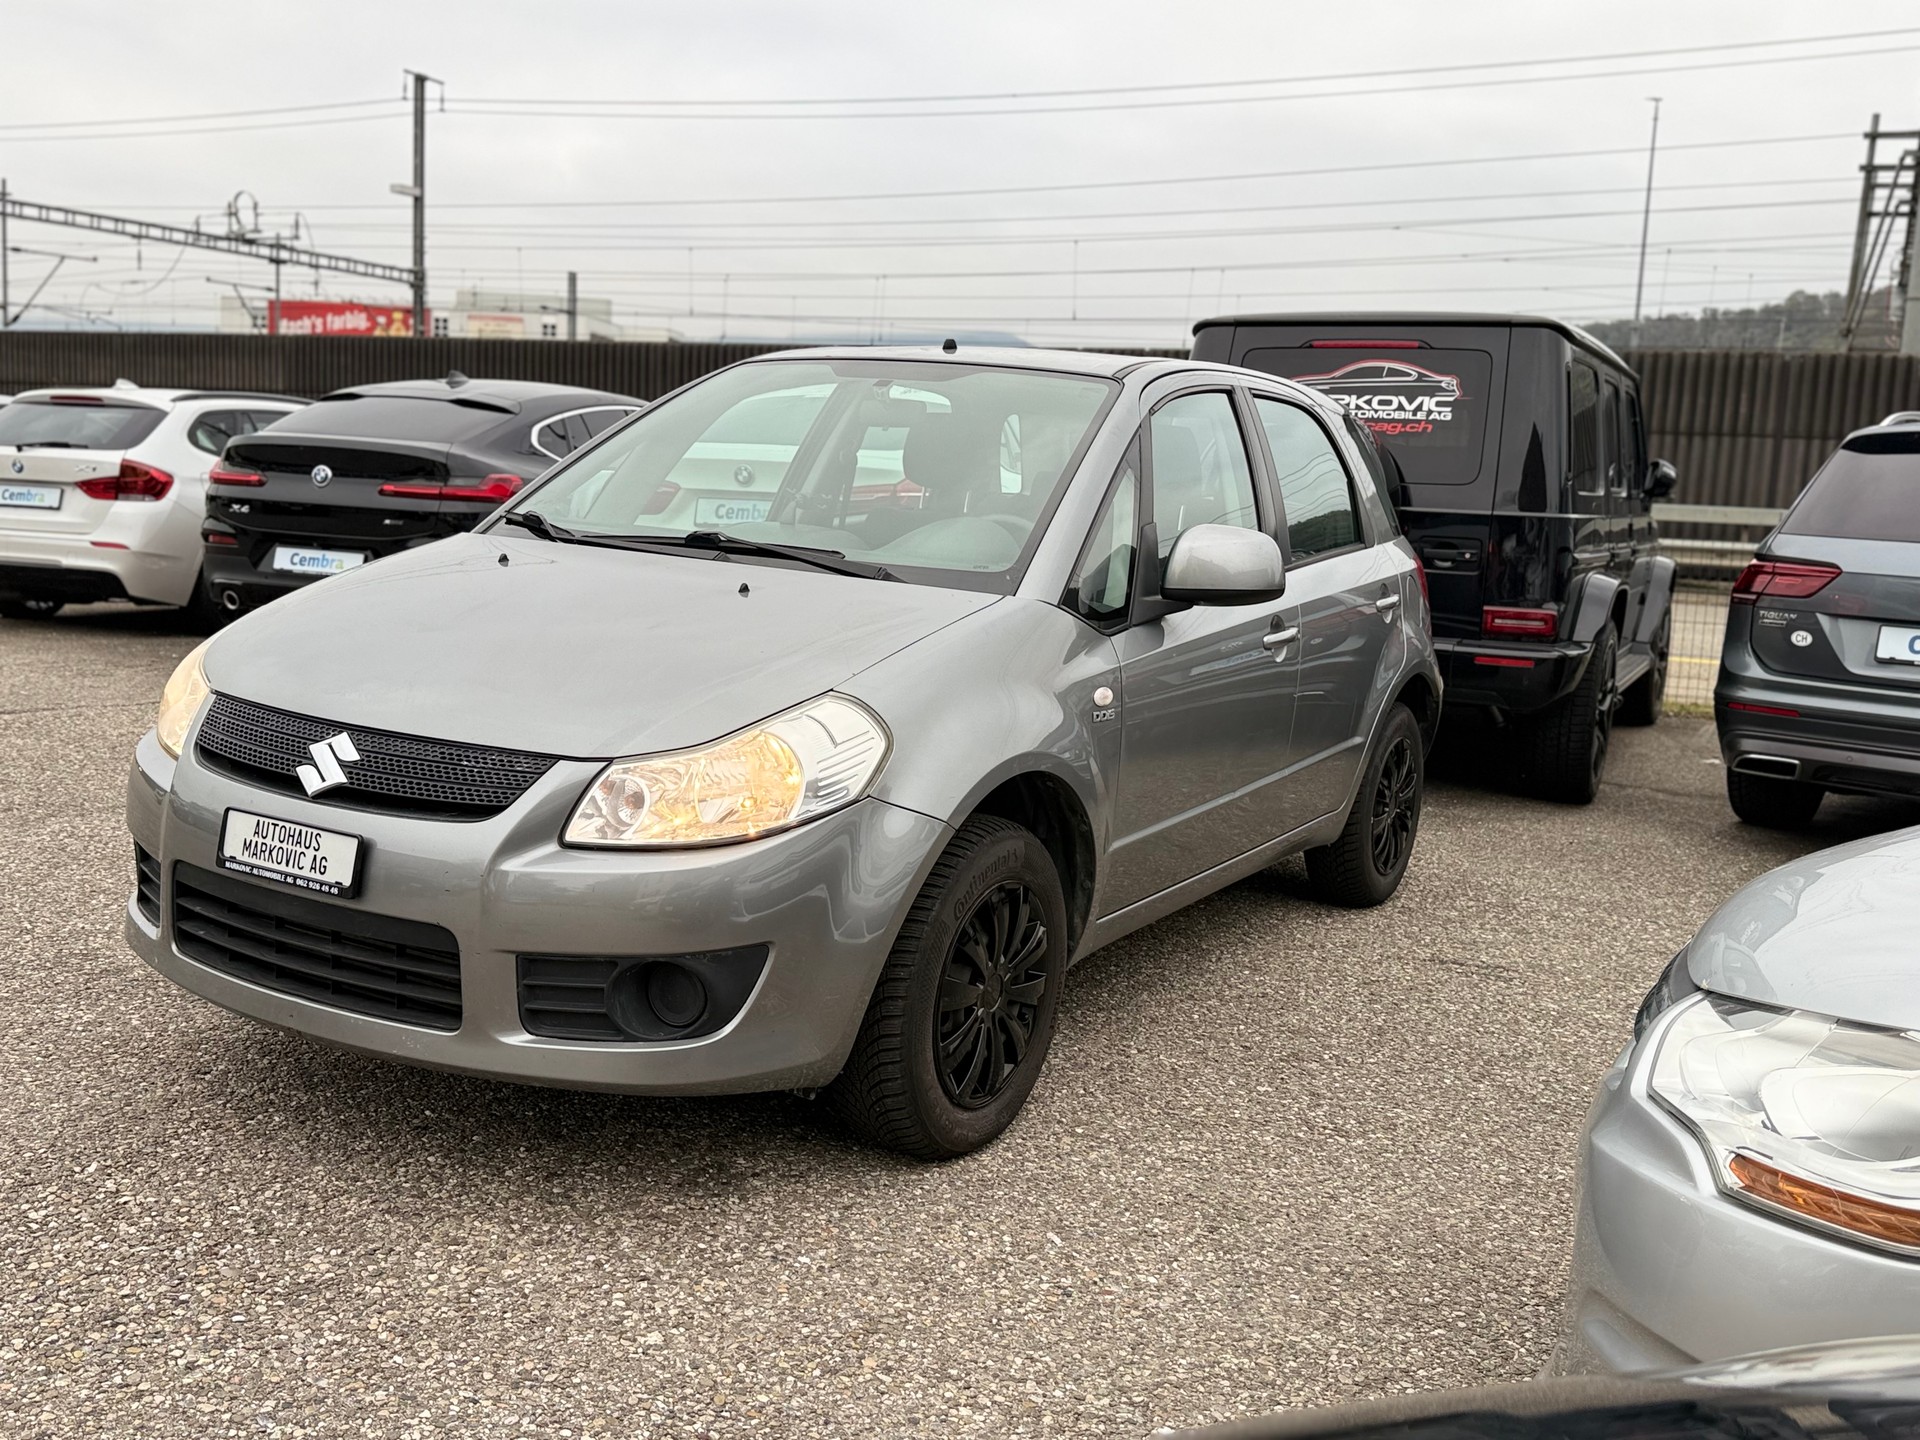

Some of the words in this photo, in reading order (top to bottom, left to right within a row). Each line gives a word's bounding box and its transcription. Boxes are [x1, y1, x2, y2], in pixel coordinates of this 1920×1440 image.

[1327, 394, 1454, 412] RKOVIC
[1349, 410, 1427, 420] TOMOBILE
[1428, 412, 1453, 421] AG
[1365, 420, 1433, 435] cag.ch
[1, 488, 46, 504] Cembra
[290, 552, 345, 570] Cembra
[1795, 633, 1808, 644] CH
[253, 819, 322, 852] AUTOHAUS
[242, 837, 306, 870] MARKOVIC
[309, 854, 328, 876] AG
[224, 860, 251, 874] MARKOVIC
[251, 866, 285, 882] AUTOMOBILE
[285, 874, 294, 884] AG
[953, 849, 1012, 922] Continental
